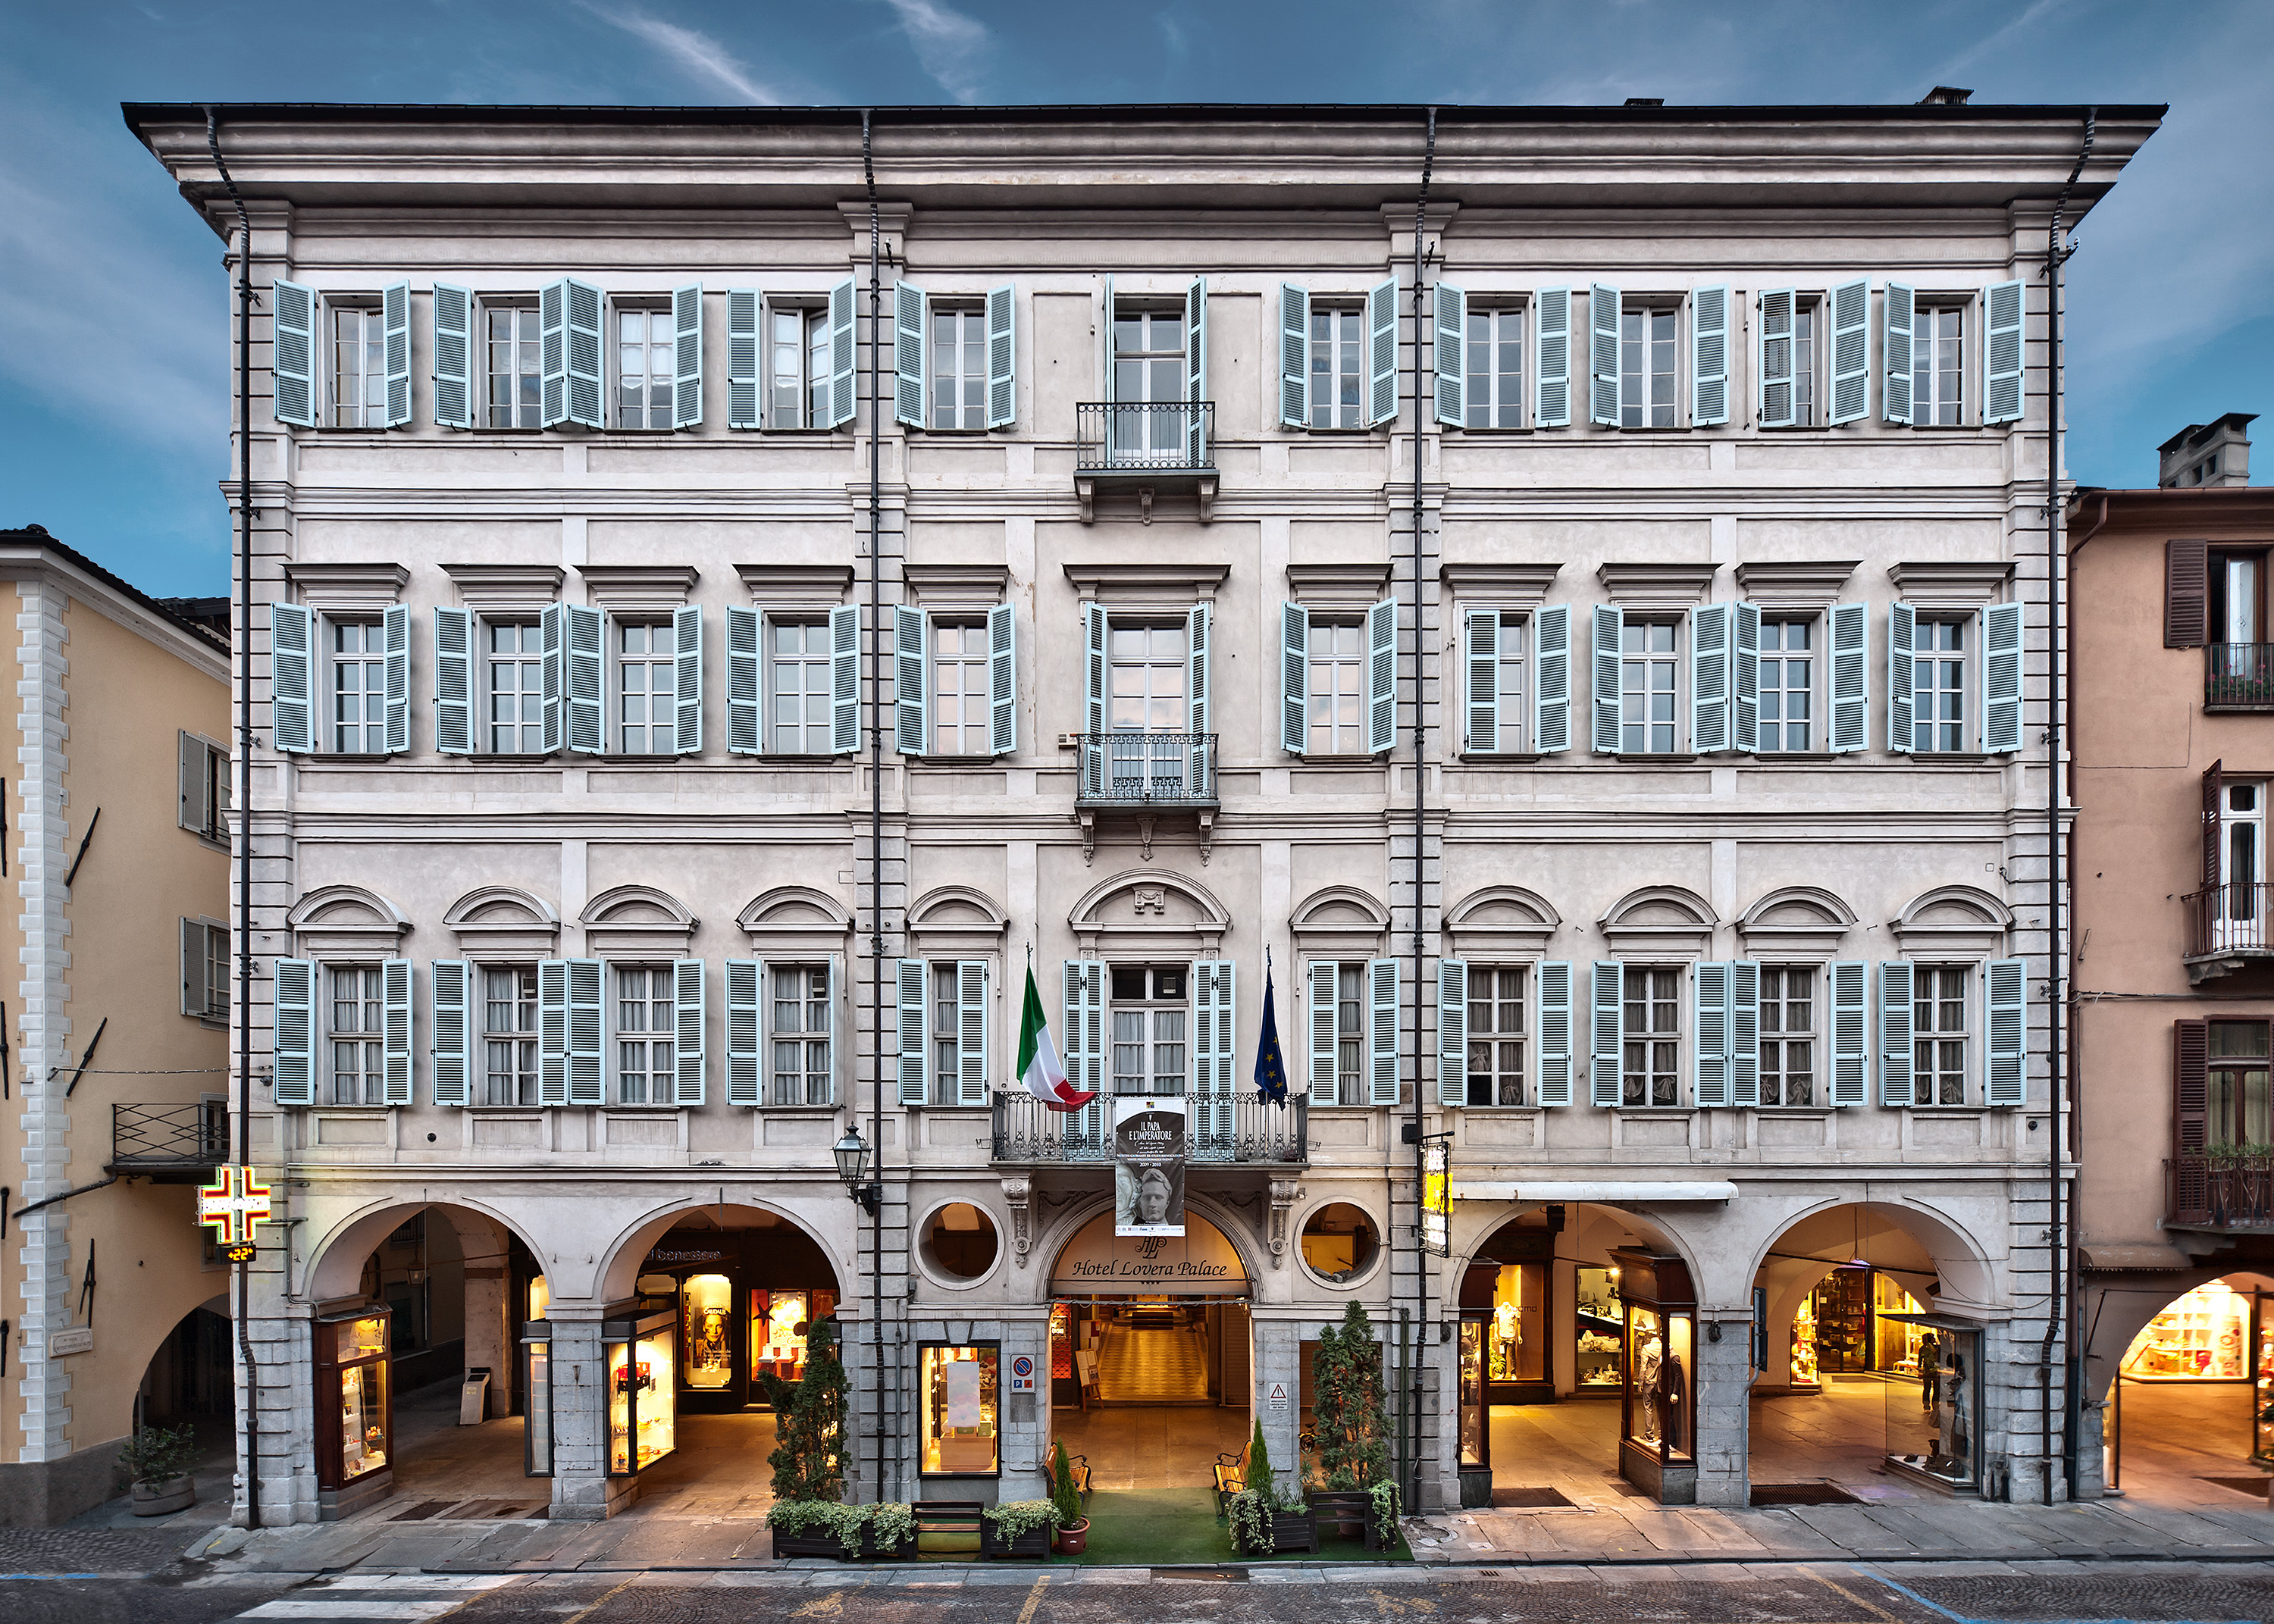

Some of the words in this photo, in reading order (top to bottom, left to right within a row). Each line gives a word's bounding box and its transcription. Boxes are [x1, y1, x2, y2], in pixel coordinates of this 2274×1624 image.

[1140, 1122, 1146, 1131] IL
[1147, 1122, 1160, 1131] PAPA
[1129, 1131, 1132, 1140] E
[1133, 1131, 1172, 1140] L'IMPERATORE
[656, 1248, 722, 1261] benessere
[1072, 1259, 1119, 1275] Hotel
[1119, 1262, 1174, 1275] Lovera
[1177, 1260, 1228, 1276] Palace
